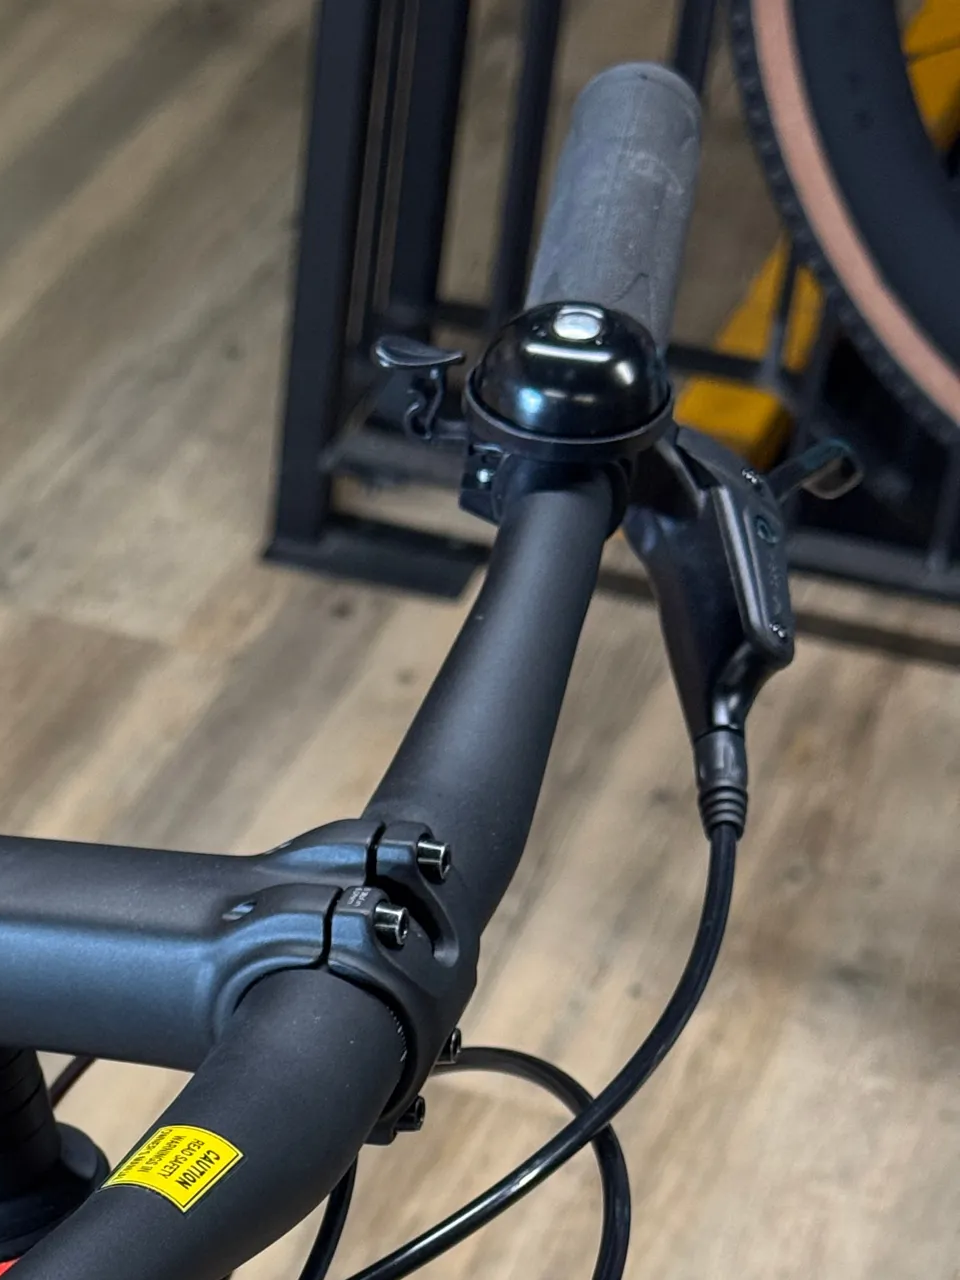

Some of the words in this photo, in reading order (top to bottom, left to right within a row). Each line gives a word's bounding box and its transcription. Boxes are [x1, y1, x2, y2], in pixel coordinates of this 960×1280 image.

[148, 1135, 187, 1166] WARNINGS
[181, 1138, 205, 1158] READ
[157, 1153, 188, 1179] SAFETY
[175, 1150, 221, 1190] CAUTION
